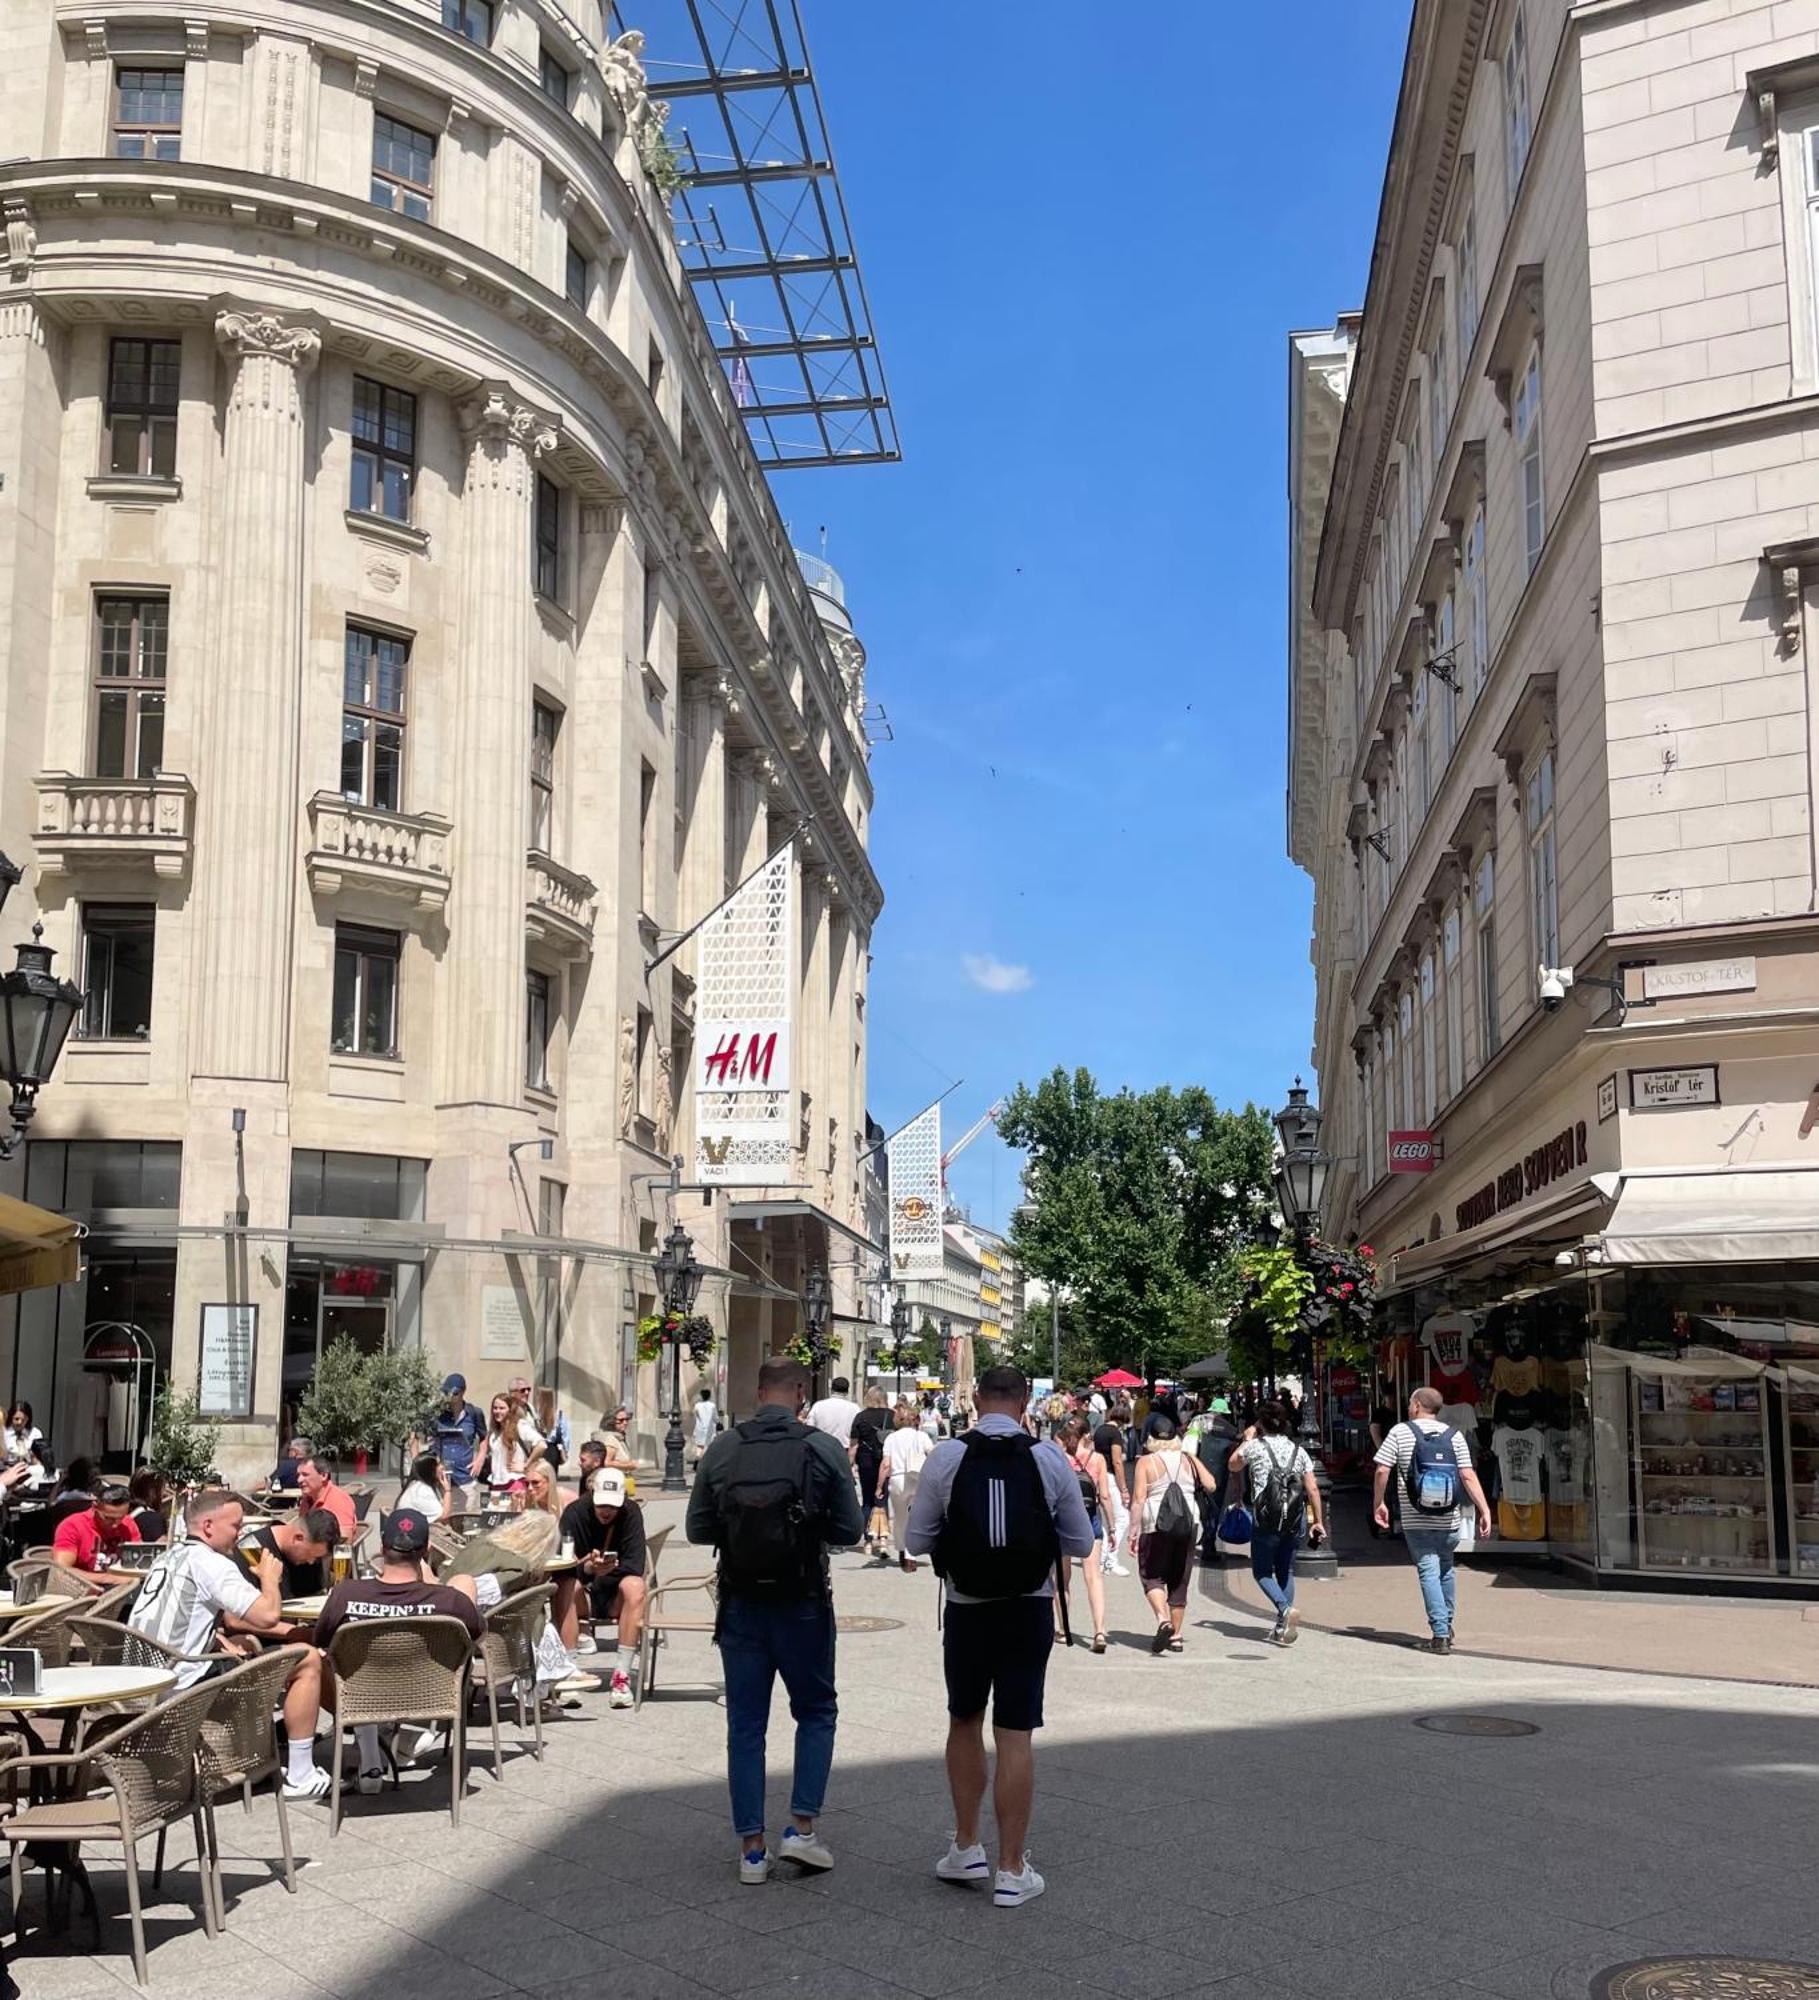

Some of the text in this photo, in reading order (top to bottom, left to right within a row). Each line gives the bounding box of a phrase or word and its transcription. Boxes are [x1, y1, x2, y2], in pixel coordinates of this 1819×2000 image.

[705, 1032, 778, 1087] H&M
[1644, 1077, 1704, 1095] Kristóf tér
[1393, 1142, 1431, 1159] LEGO
[134, 1566, 167, 1615] 9
[417, 1604, 435, 1615] IT
